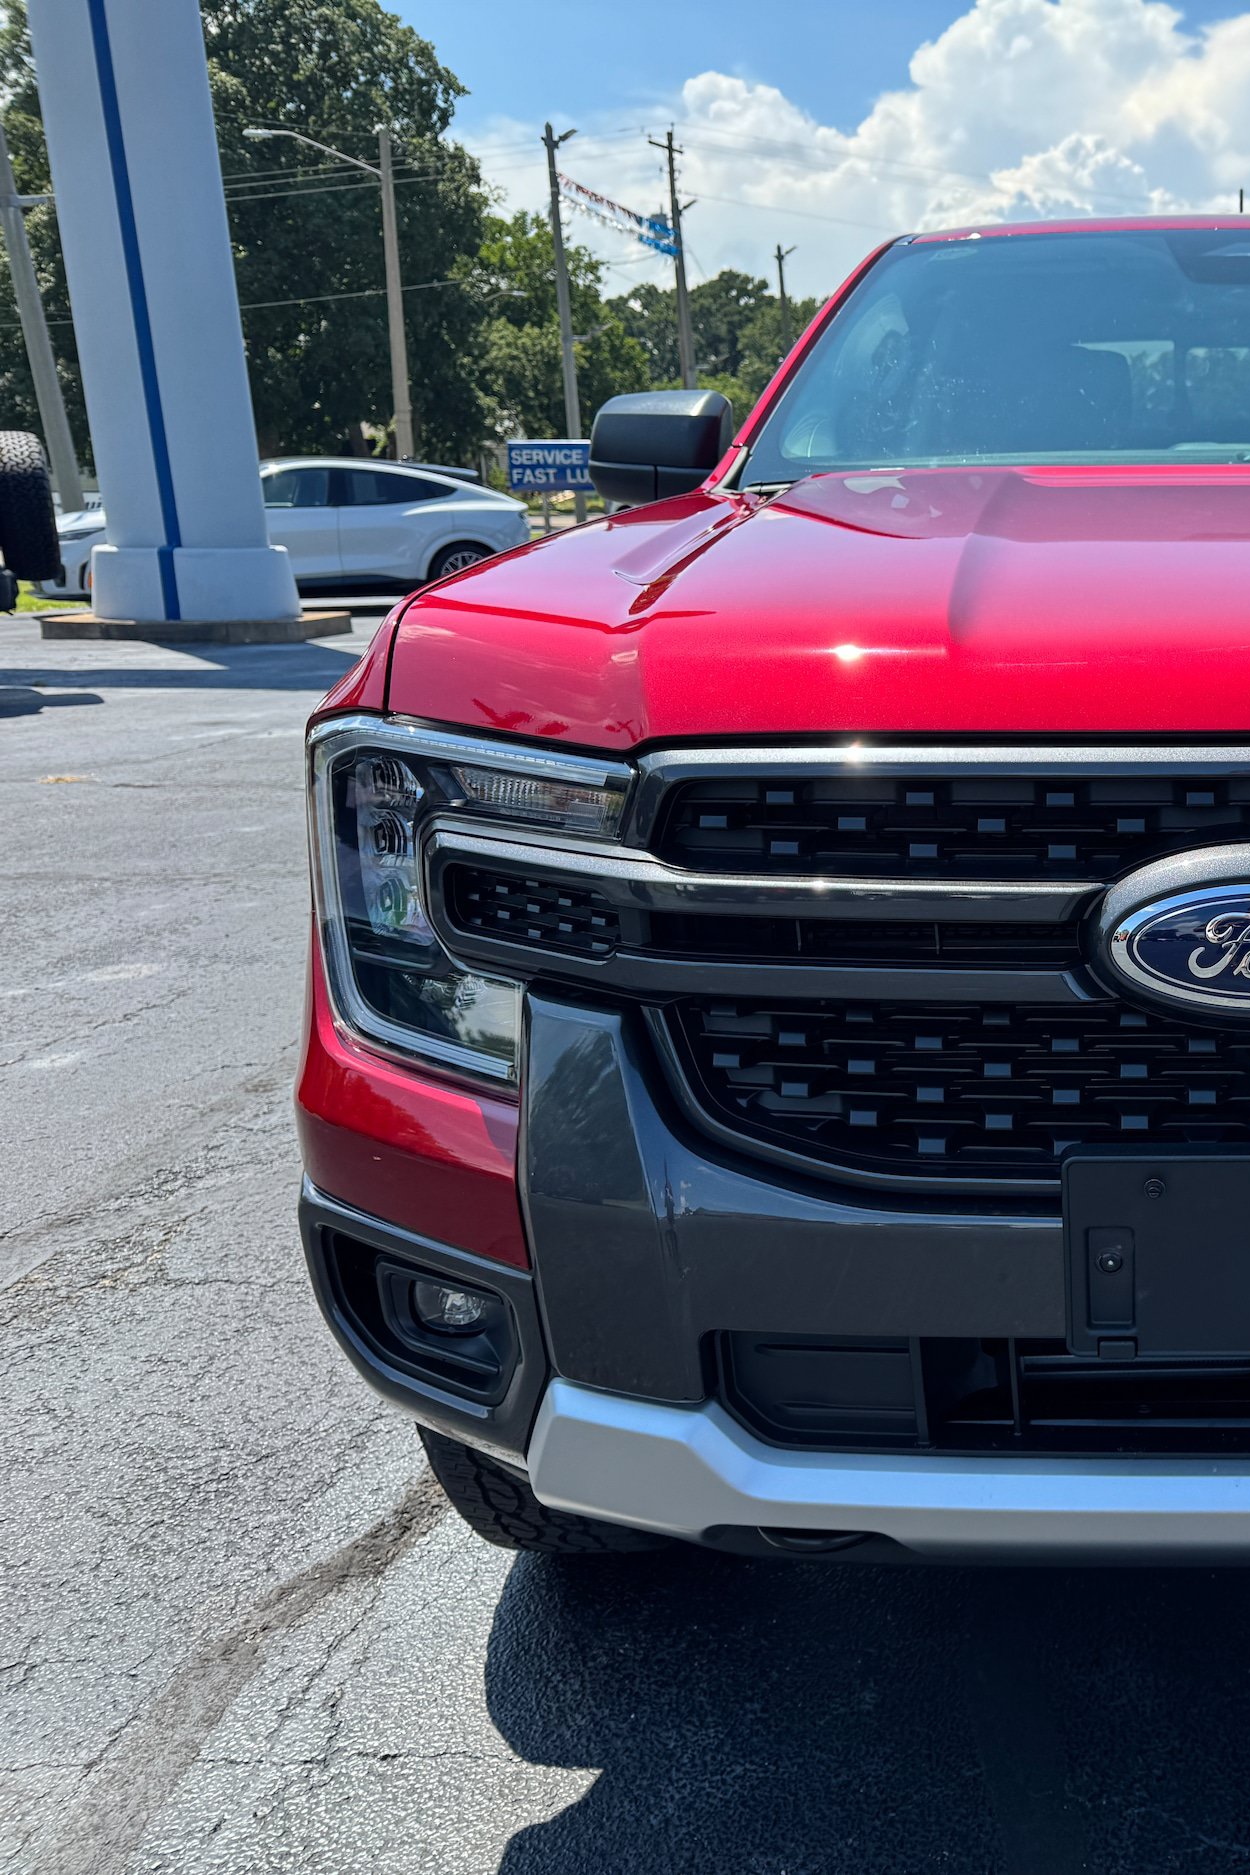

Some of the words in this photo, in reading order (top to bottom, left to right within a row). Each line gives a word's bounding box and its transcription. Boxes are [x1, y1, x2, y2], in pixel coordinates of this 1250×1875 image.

[511, 448, 583, 465] SERVICE
[512, 468, 557, 484] FAST
[566, 467, 592, 484] LU
